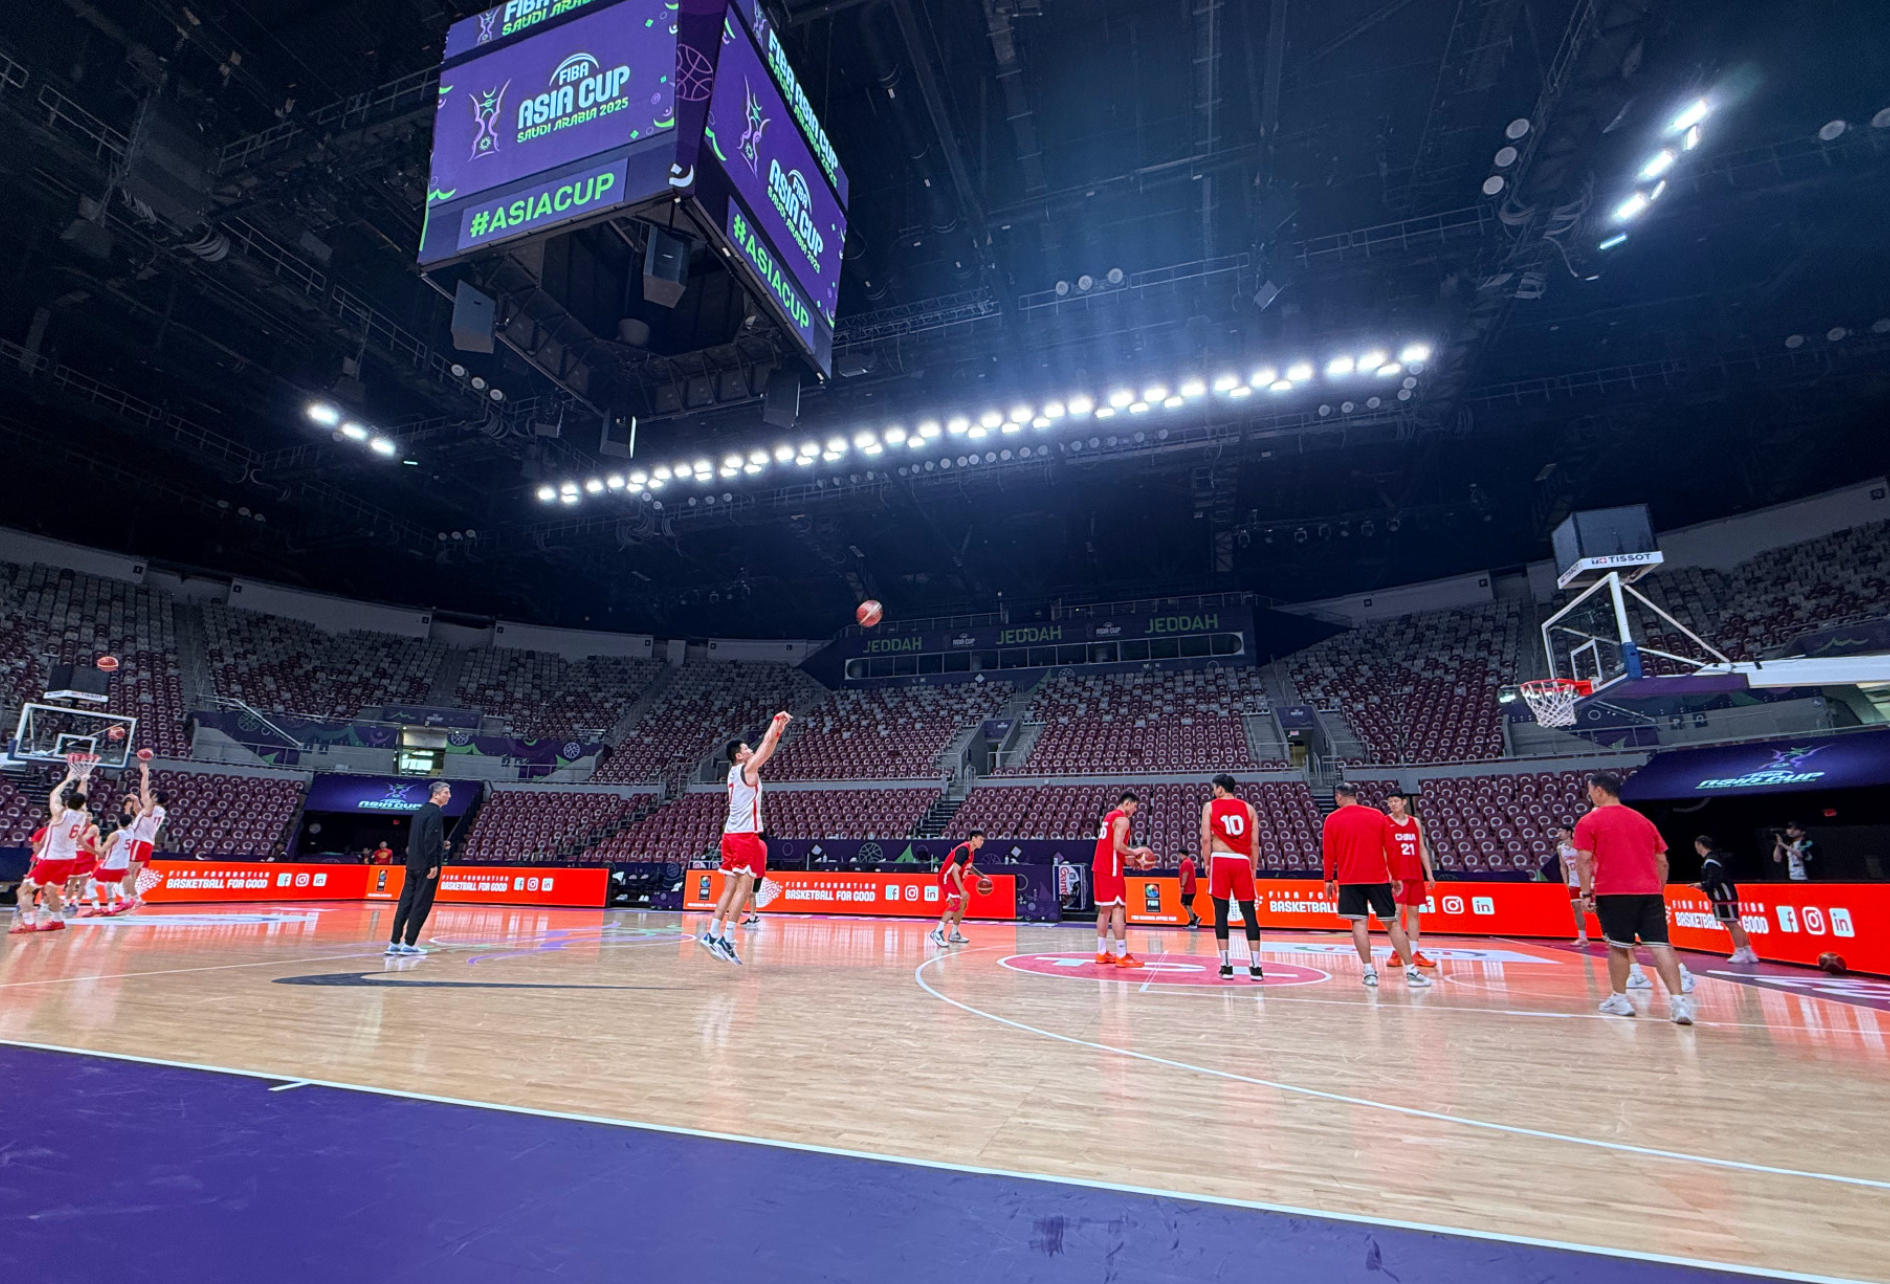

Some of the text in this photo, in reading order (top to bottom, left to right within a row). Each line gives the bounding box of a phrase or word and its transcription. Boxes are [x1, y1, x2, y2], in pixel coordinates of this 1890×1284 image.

[502, 8, 547, 36] SAUDI
[559, 61, 589, 85] FIBA
[518, 65, 631, 129] ASIA CUP
[768, 28, 839, 170] FIBA ASIA CUP
[517, 97, 629, 144] SAUDI ARABIA 2025
[793, 177, 808, 209] FIBA
[470, 172, 615, 238] #ASIACUP
[767, 185, 786, 222] SAUDI
[769, 159, 824, 257] ASIA CUP
[733, 213, 809, 329] #ASIACUP
[1608, 553, 1651, 564] TISSOT
[1144, 614, 1219, 634] JEDDAH
[863, 637, 923, 653] JEDDAH
[996, 625, 1062, 645] JEDDAH
[1219, 814, 1244, 836] 10
[124, 839, 131, 850] 5
[1395, 833, 1416, 842] CHINA
[1401, 843, 1415, 856] 21
[166, 878, 268, 889] BASKETBALL FOR GOOD
[785, 889, 875, 902] BASKETBALL FOR GOOD
[1268, 890, 1300, 899] FIBA
[1270, 900, 1338, 914] BASKETBALL
[1742, 915, 1769, 934] GOOD
